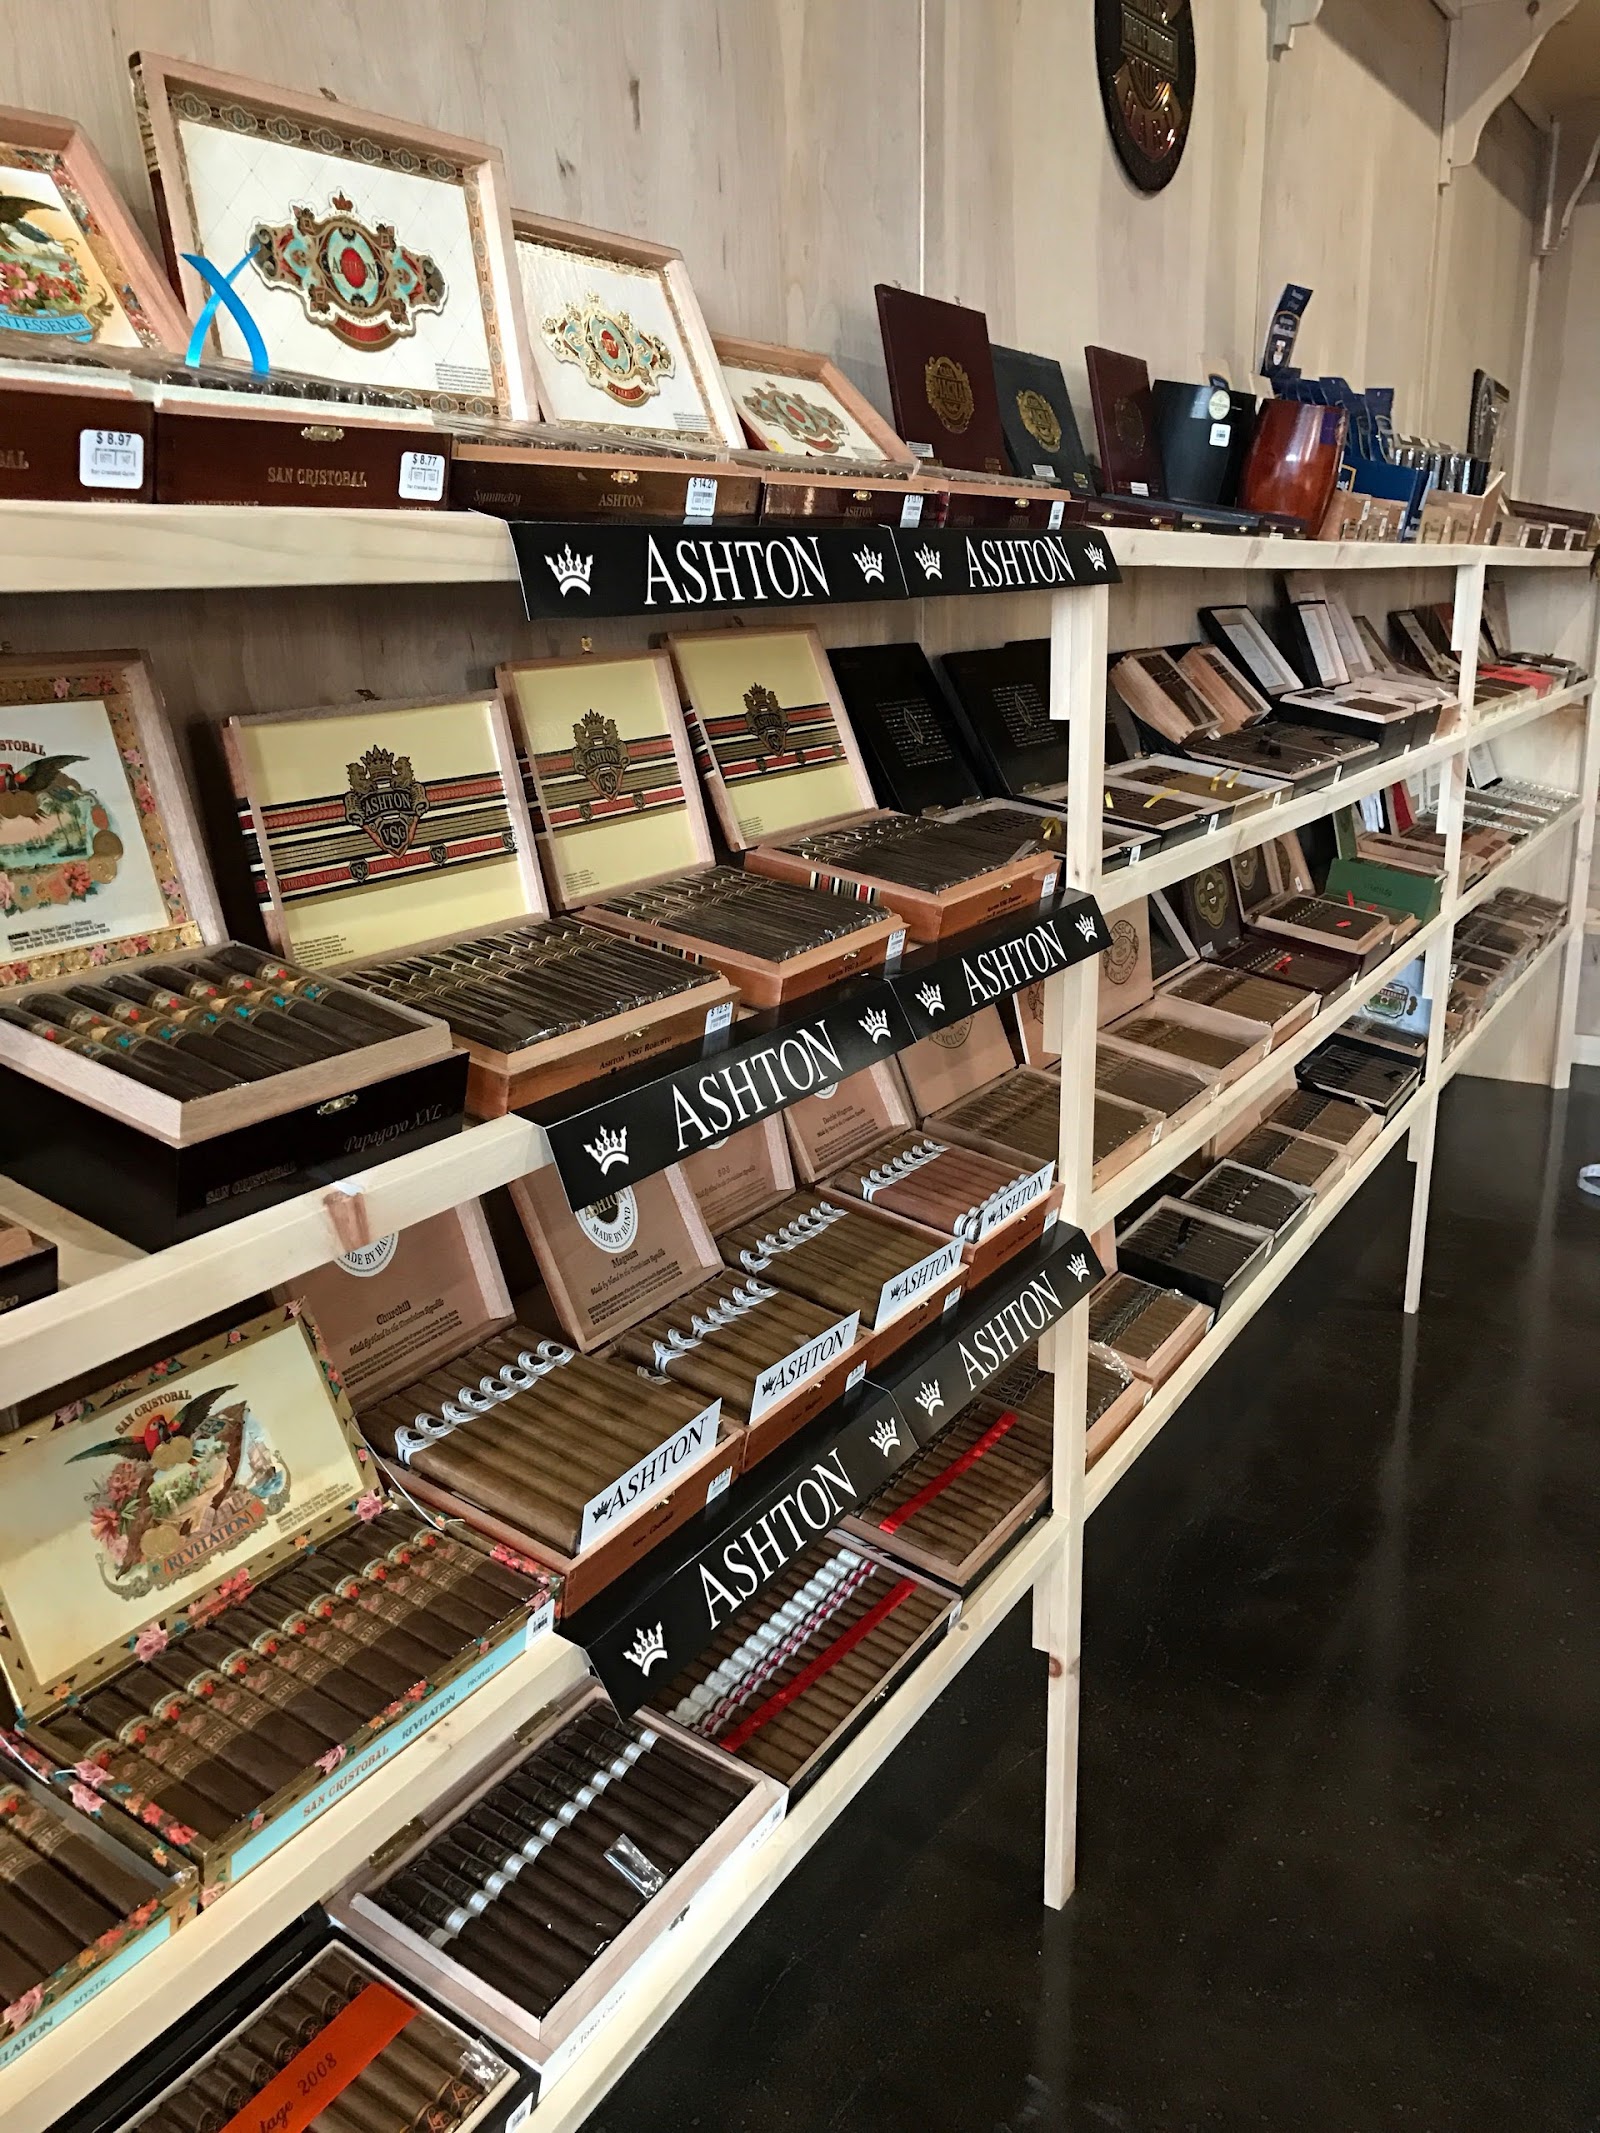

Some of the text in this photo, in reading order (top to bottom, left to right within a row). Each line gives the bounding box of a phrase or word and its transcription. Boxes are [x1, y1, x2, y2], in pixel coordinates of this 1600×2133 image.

[96, 431, 131, 446] $ 8.97
[267, 466, 367, 487] SAN CRISTOBAL
[412, 453, 438, 466] $ 8.77
[599, 493, 644, 508] ASHTON
[843, 506, 873, 518] ASHTON
[644, 534, 831, 605] ASHTON
[965, 536, 1076, 588] ASHTON
[0, 739, 46, 757] STOBAL
[586, 749, 618, 766] ASHTON
[365, 793, 411, 817] ASHTON
[382, 826, 406, 846] VSG
[350, 863, 368, 878] VSG
[962, 920, 1068, 1006] ASHTON
[599, 1054, 625, 1070] ASHTON
[627, 1046, 643, 1059] VSG
[673, 1020, 843, 1151] ASHTON
[344, 1119, 409, 1152] Papagayo
[994, 1171, 1048, 1225] ASHTON
[592, 1206, 632, 1243] MADE BY HAND
[344, 1252, 362, 1265] ADE
[365, 1254, 377, 1265] BY
[611, 1249, 639, 1268] Magnum
[897, 1245, 959, 1302] ASHTON
[376, 1300, 412, 1325] Churchill
[958, 1270, 1063, 1392] ASHTON
[771, 1324, 848, 1396] ASHTON
[115, 1389, 192, 1435] SAN CRISTOBAL
[607, 1416, 707, 1520] ASHTON
[166, 1515, 250, 1574] REVELATION
[698, 1447, 858, 1631] ASHTON
[303, 1793, 325, 1818] SAN
[328, 1745, 389, 1799] CRISTOBAL
[402, 1692, 456, 1740] REVELATION
[0, 2016, 54, 2061] LATION
[299, 2051, 338, 2097] 2008
